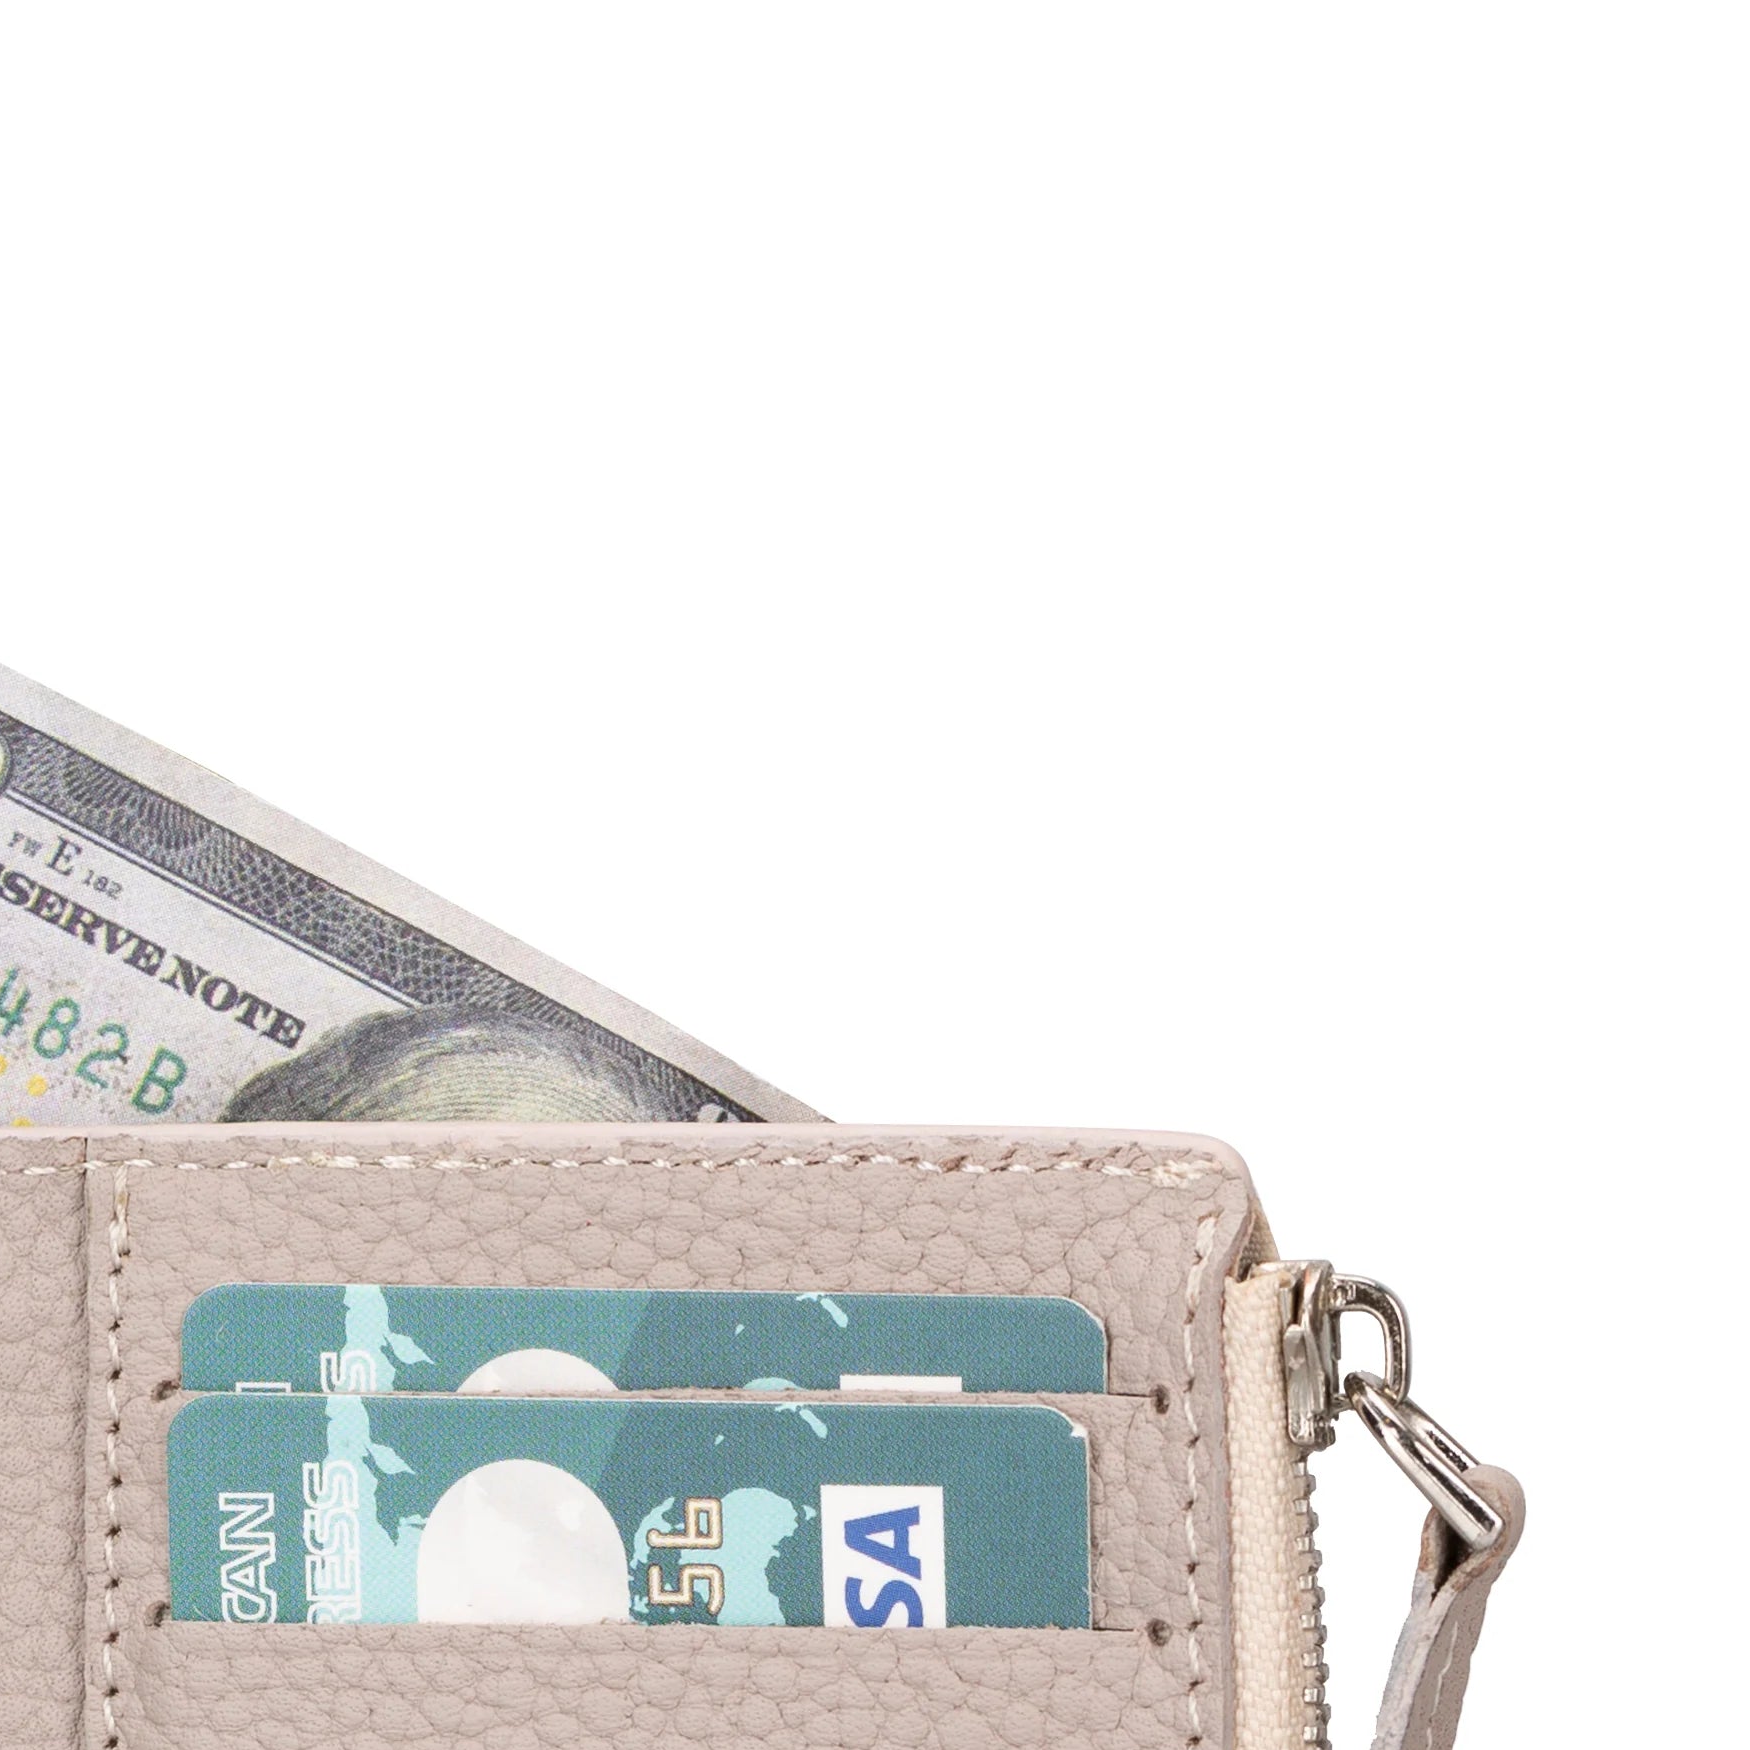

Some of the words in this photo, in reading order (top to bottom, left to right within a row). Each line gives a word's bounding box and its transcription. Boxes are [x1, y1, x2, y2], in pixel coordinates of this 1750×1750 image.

[46, 835, 82, 876] E
[82, 868, 123, 900] 182
[159, 953, 307, 1049] NOTE
